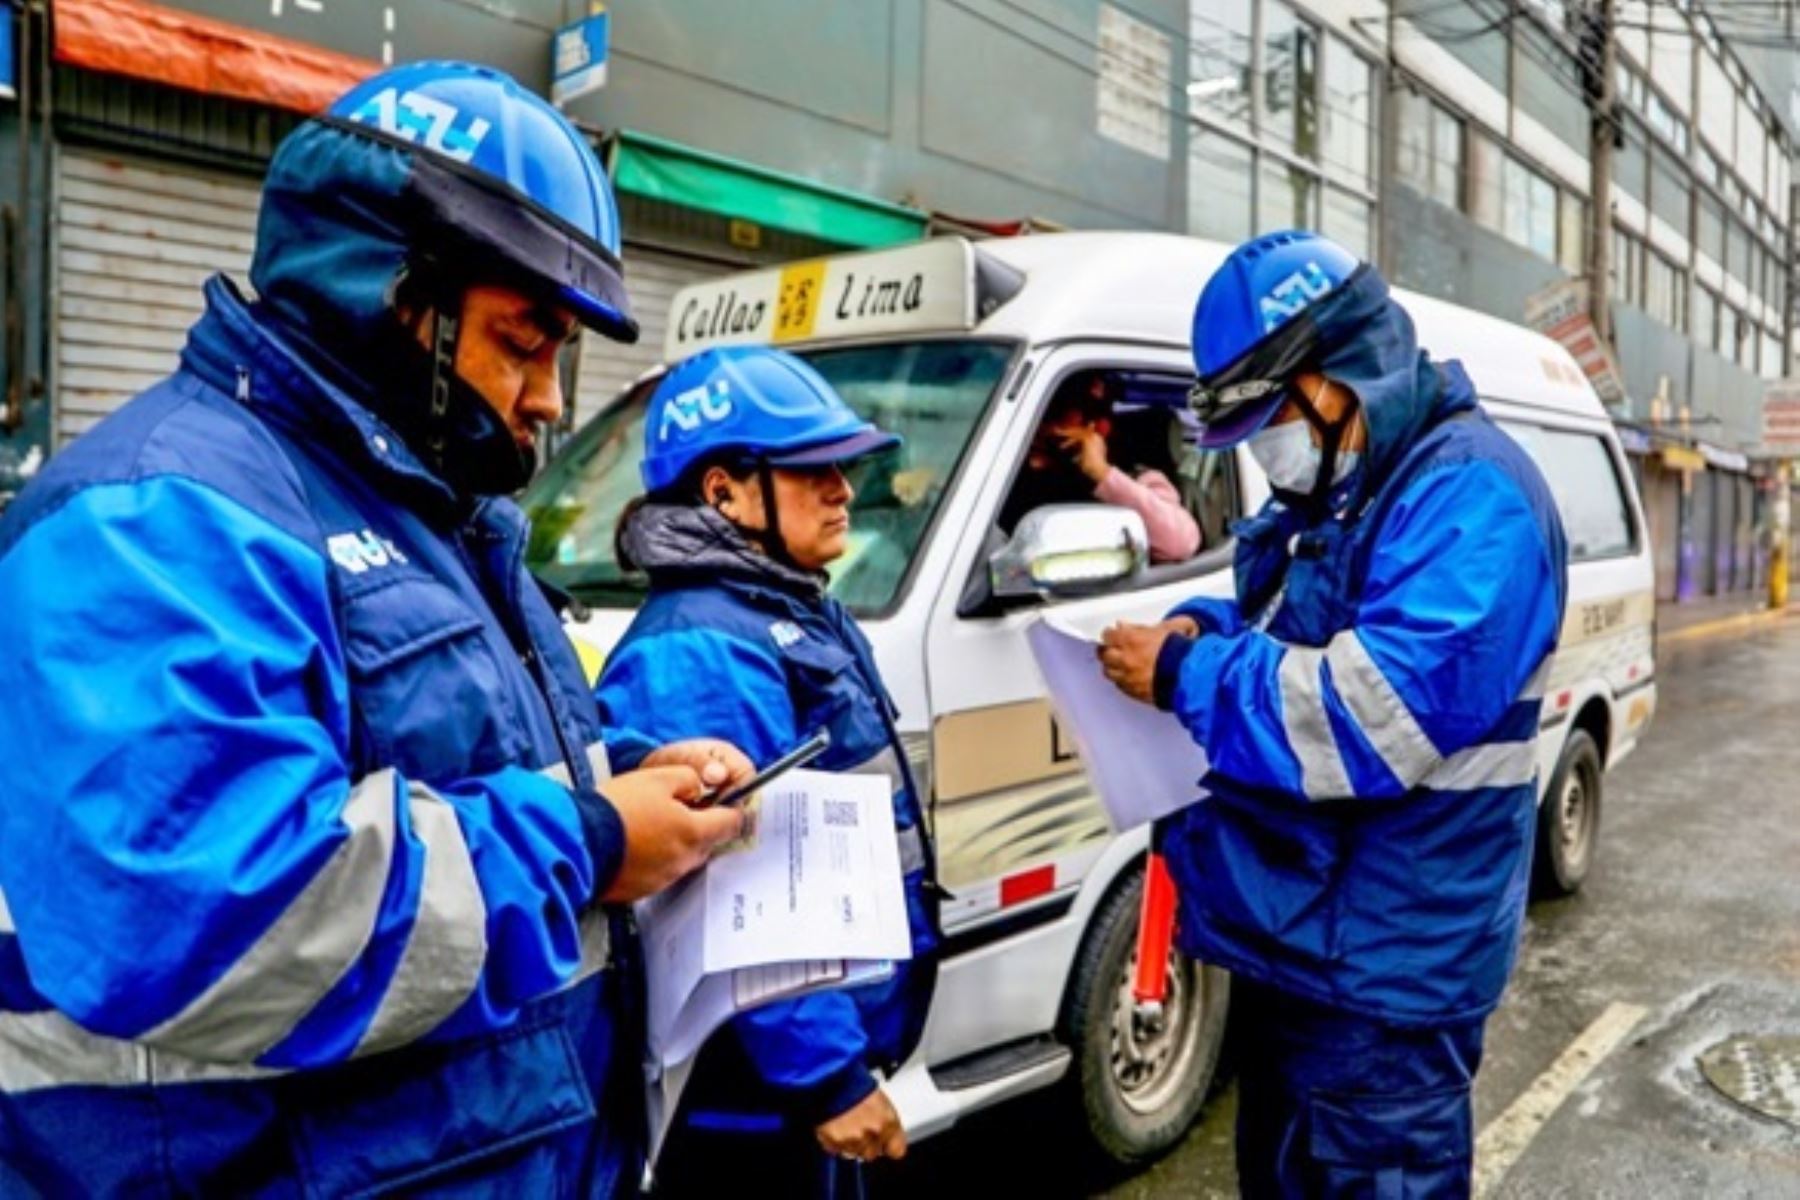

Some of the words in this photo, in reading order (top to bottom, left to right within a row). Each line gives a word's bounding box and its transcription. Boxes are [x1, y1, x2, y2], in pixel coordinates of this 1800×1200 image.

[349, 87, 491, 164] ATU
[678, 291, 766, 342] Callao
[836, 273, 923, 320] Lima
[1260, 261, 1333, 334] ATU
[660, 380, 731, 441] ATU
